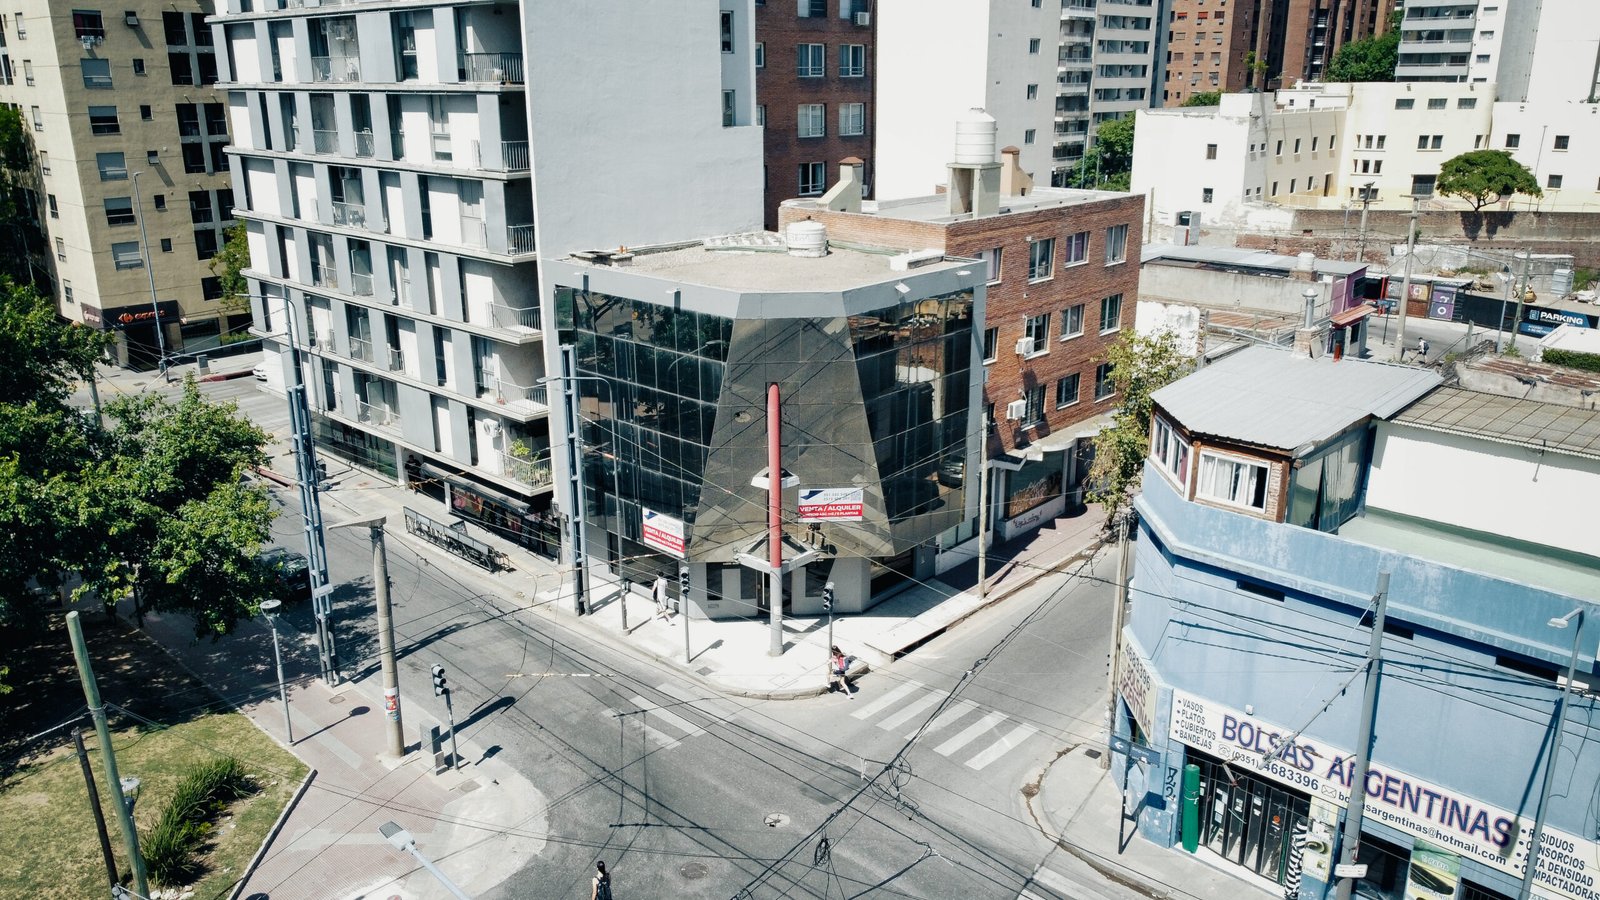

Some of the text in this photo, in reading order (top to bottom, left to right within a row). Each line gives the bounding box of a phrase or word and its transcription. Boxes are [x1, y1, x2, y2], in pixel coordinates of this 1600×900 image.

[1540, 311, 1584, 325] PARKING
[827, 504, 861, 512] ALQUILER
[1182, 698, 1204, 714] VASOS
[1181, 709, 1206, 726] PLATOS
[1179, 730, 1213, 750] BANDEJAS
[1180, 719, 1217, 741] CUBIERTOS
[1528, 828, 1575, 854] RSIDUOS
[1526, 840, 1586, 871] CNSORCIOS
[1521, 864, 1600, 900] CMPACTADORAS
[1547, 861, 1594, 887] DENSIDAD
